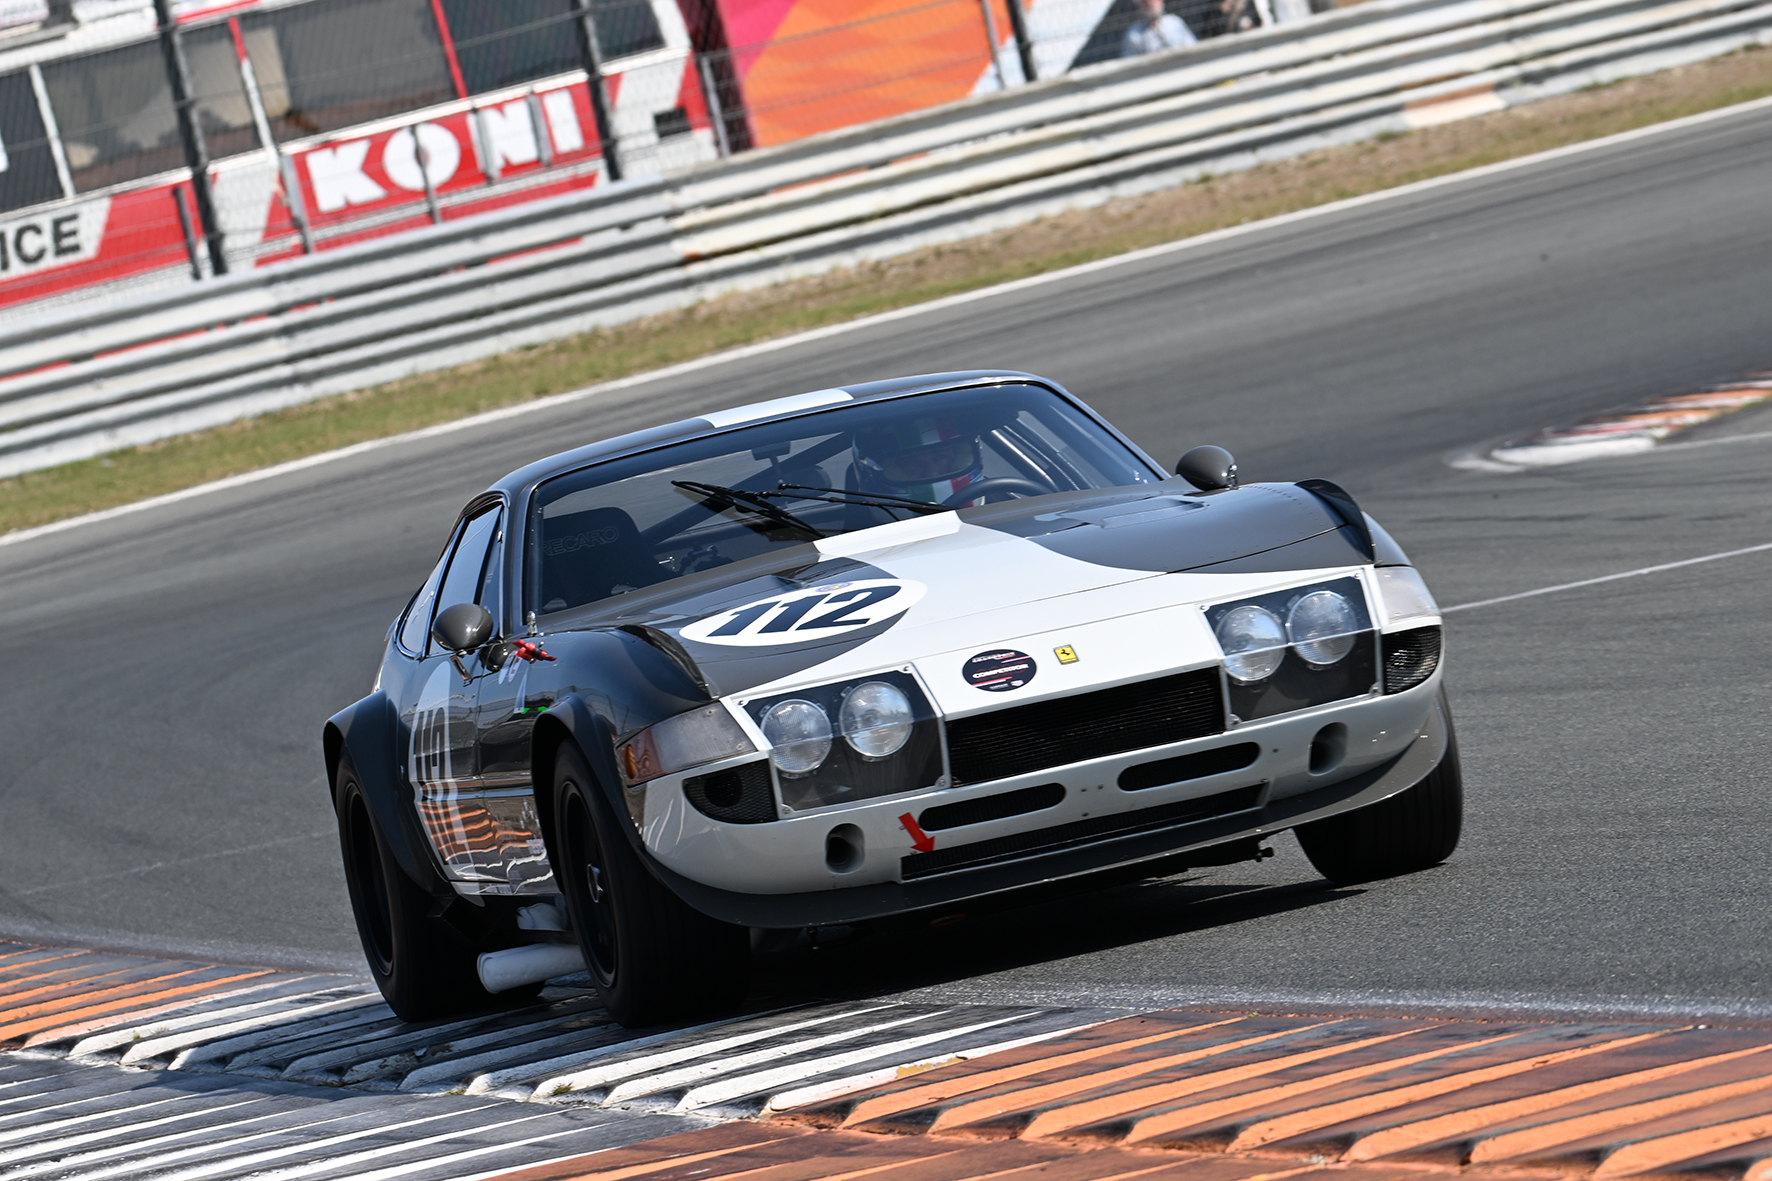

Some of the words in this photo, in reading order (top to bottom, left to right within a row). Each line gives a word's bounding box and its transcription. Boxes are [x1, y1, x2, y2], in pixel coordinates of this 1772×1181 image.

[305, 89, 585, 213] KONI
[542, 526, 619, 556] RECARO
[706, 585, 902, 638] 112
